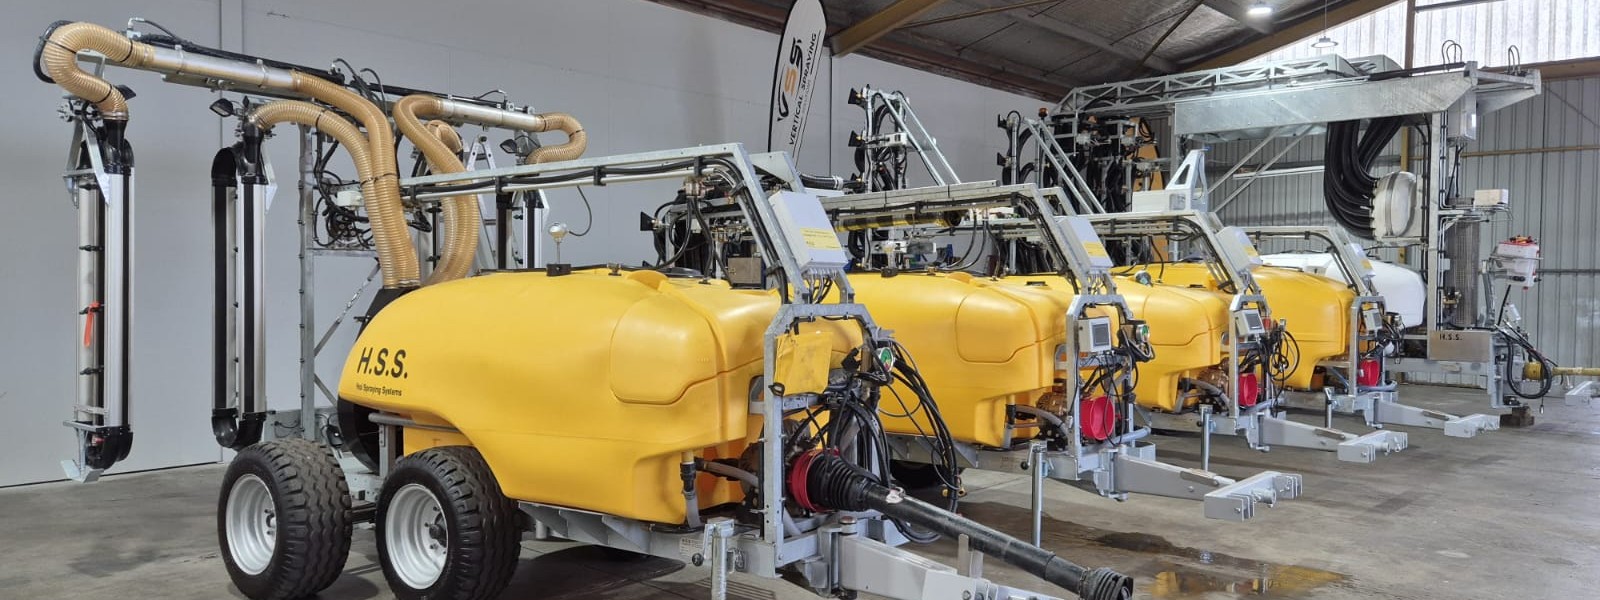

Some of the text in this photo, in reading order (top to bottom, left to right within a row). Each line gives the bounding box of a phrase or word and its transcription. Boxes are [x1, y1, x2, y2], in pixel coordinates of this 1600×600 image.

[789, 33, 816, 145] VERTICAL SPRAYING
[357, 346, 408, 379] H.S.S.
[382, 386, 402, 397] Systems
